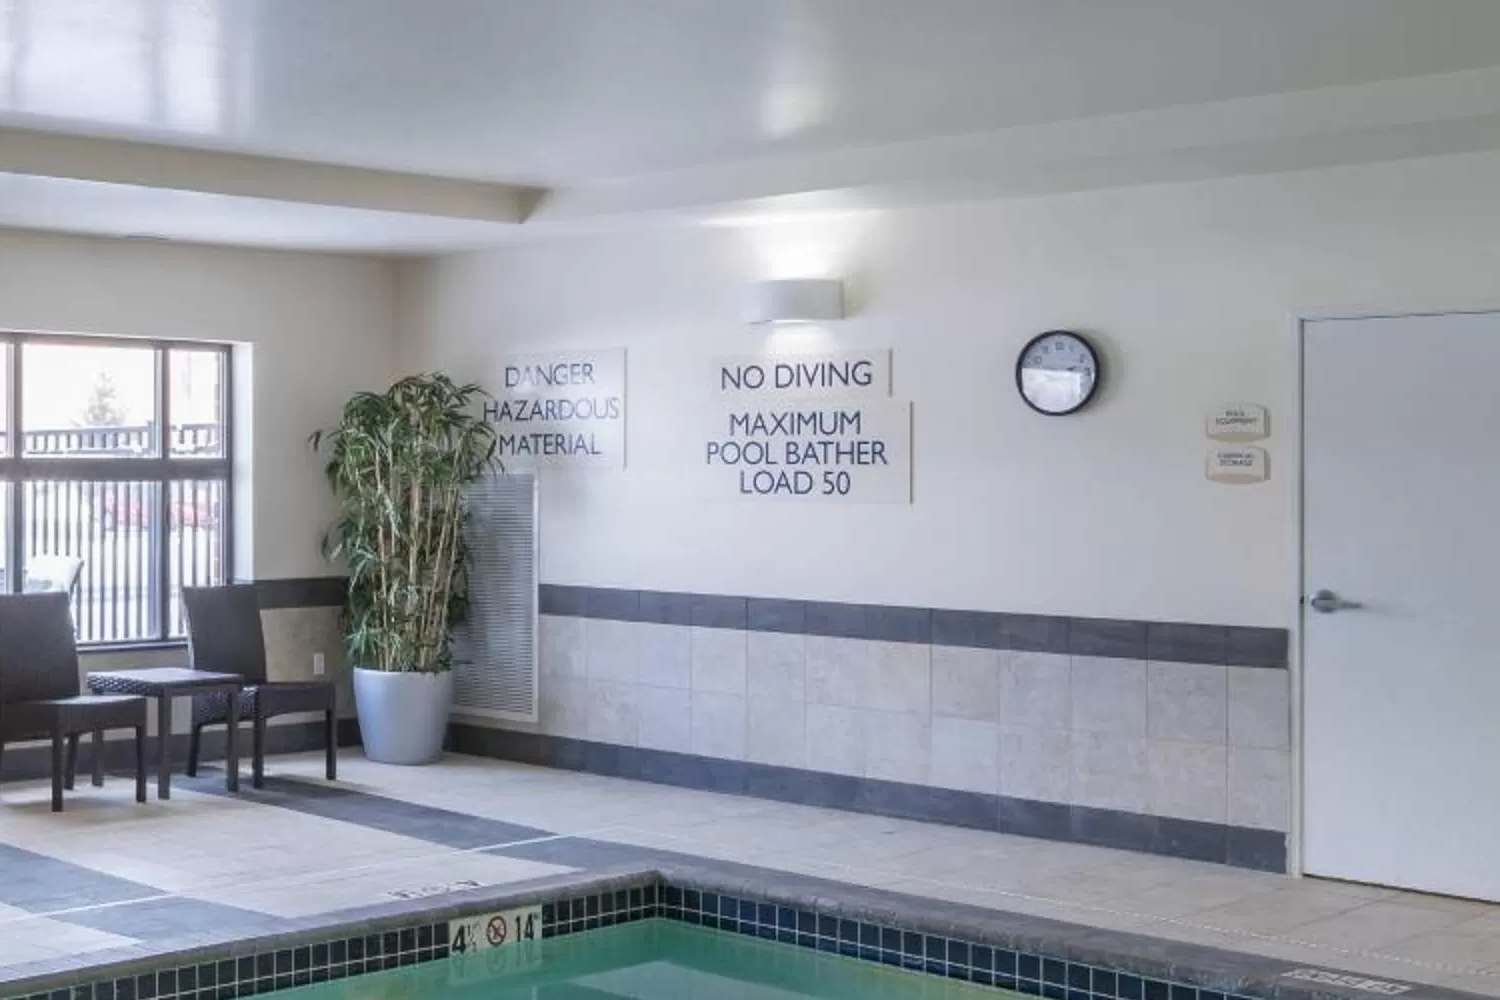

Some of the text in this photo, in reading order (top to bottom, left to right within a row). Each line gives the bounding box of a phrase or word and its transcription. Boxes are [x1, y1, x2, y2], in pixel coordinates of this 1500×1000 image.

[505, 363, 595, 388] DANGER
[720, 361, 873, 390] NO DIVING
[483, 397, 619, 422] HAZARDOUS
[729, 411, 861, 436] MAXIMUM
[500, 433, 603, 455] MATERIAL
[706, 441, 888, 465] POOL BATHER
[739, 470, 851, 495] LOAD 50
